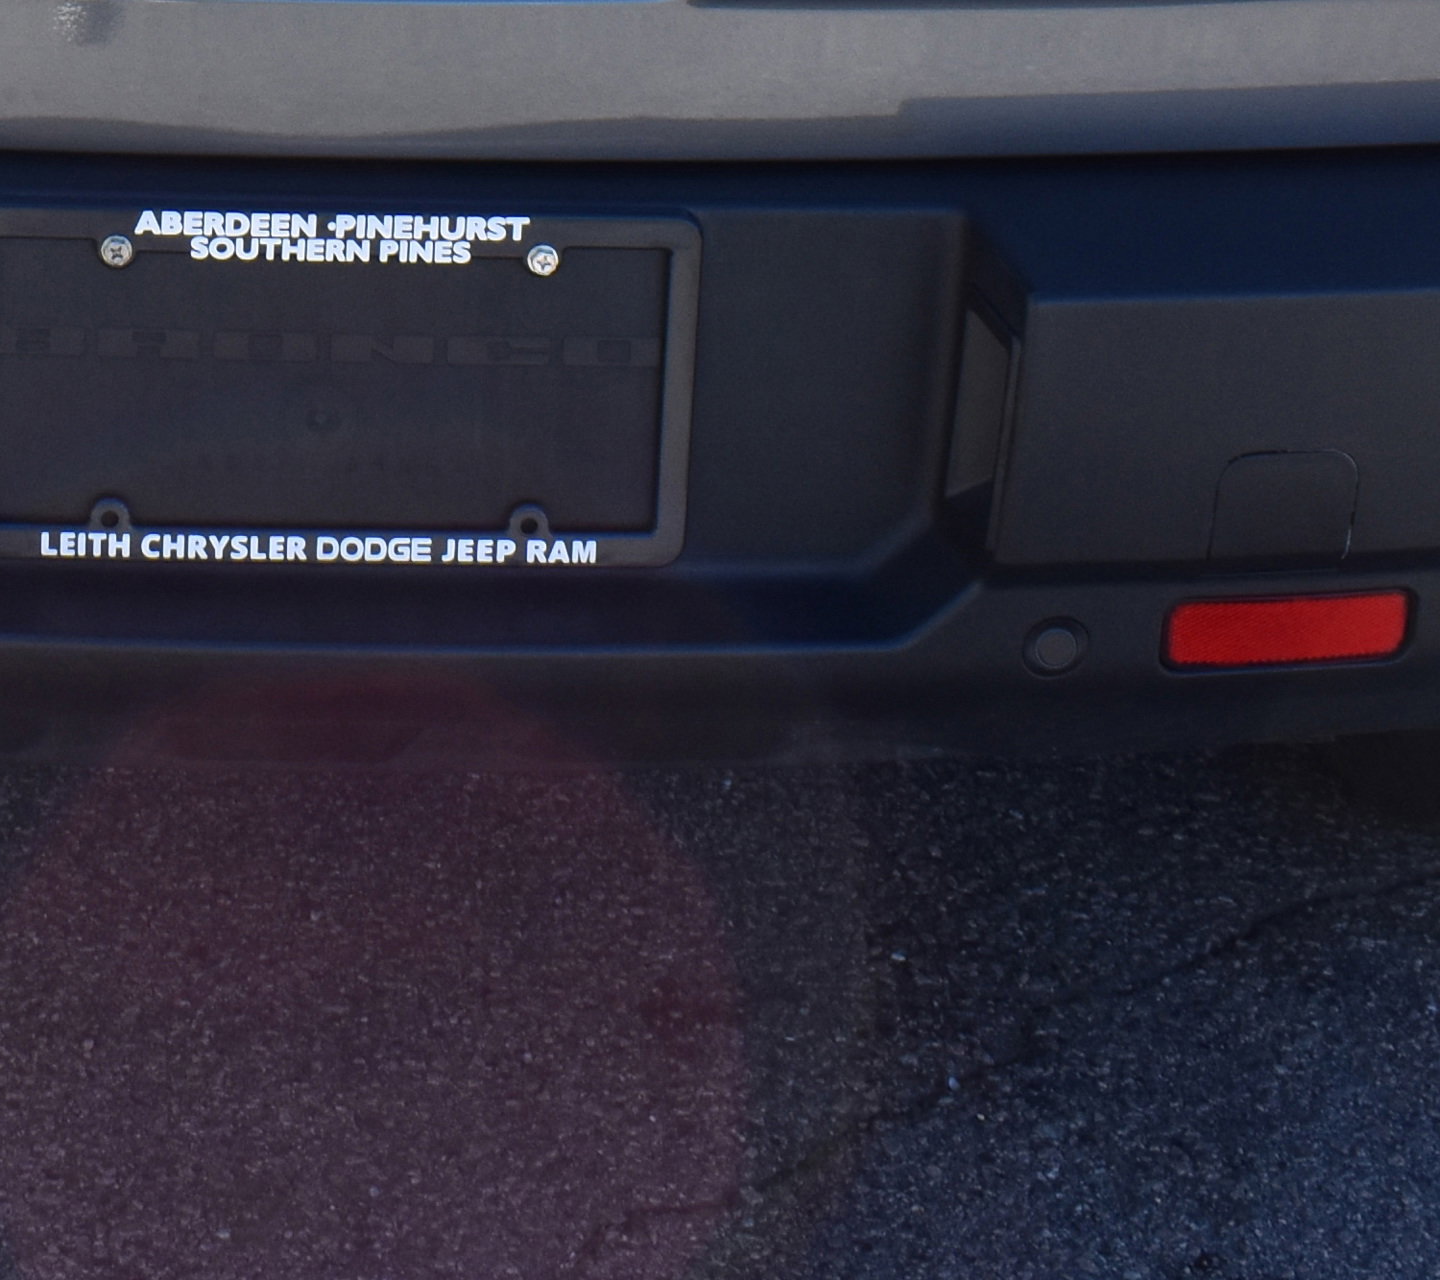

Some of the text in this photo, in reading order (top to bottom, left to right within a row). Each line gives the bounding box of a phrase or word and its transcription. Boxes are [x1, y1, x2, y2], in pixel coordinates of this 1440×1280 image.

[133, 209, 318, 238] ABERDEEN
[189, 236, 472, 264] SOUTHERN PINES
[39, 531, 597, 564] LEITH CHRYSLER DODGE JEEP RAM
